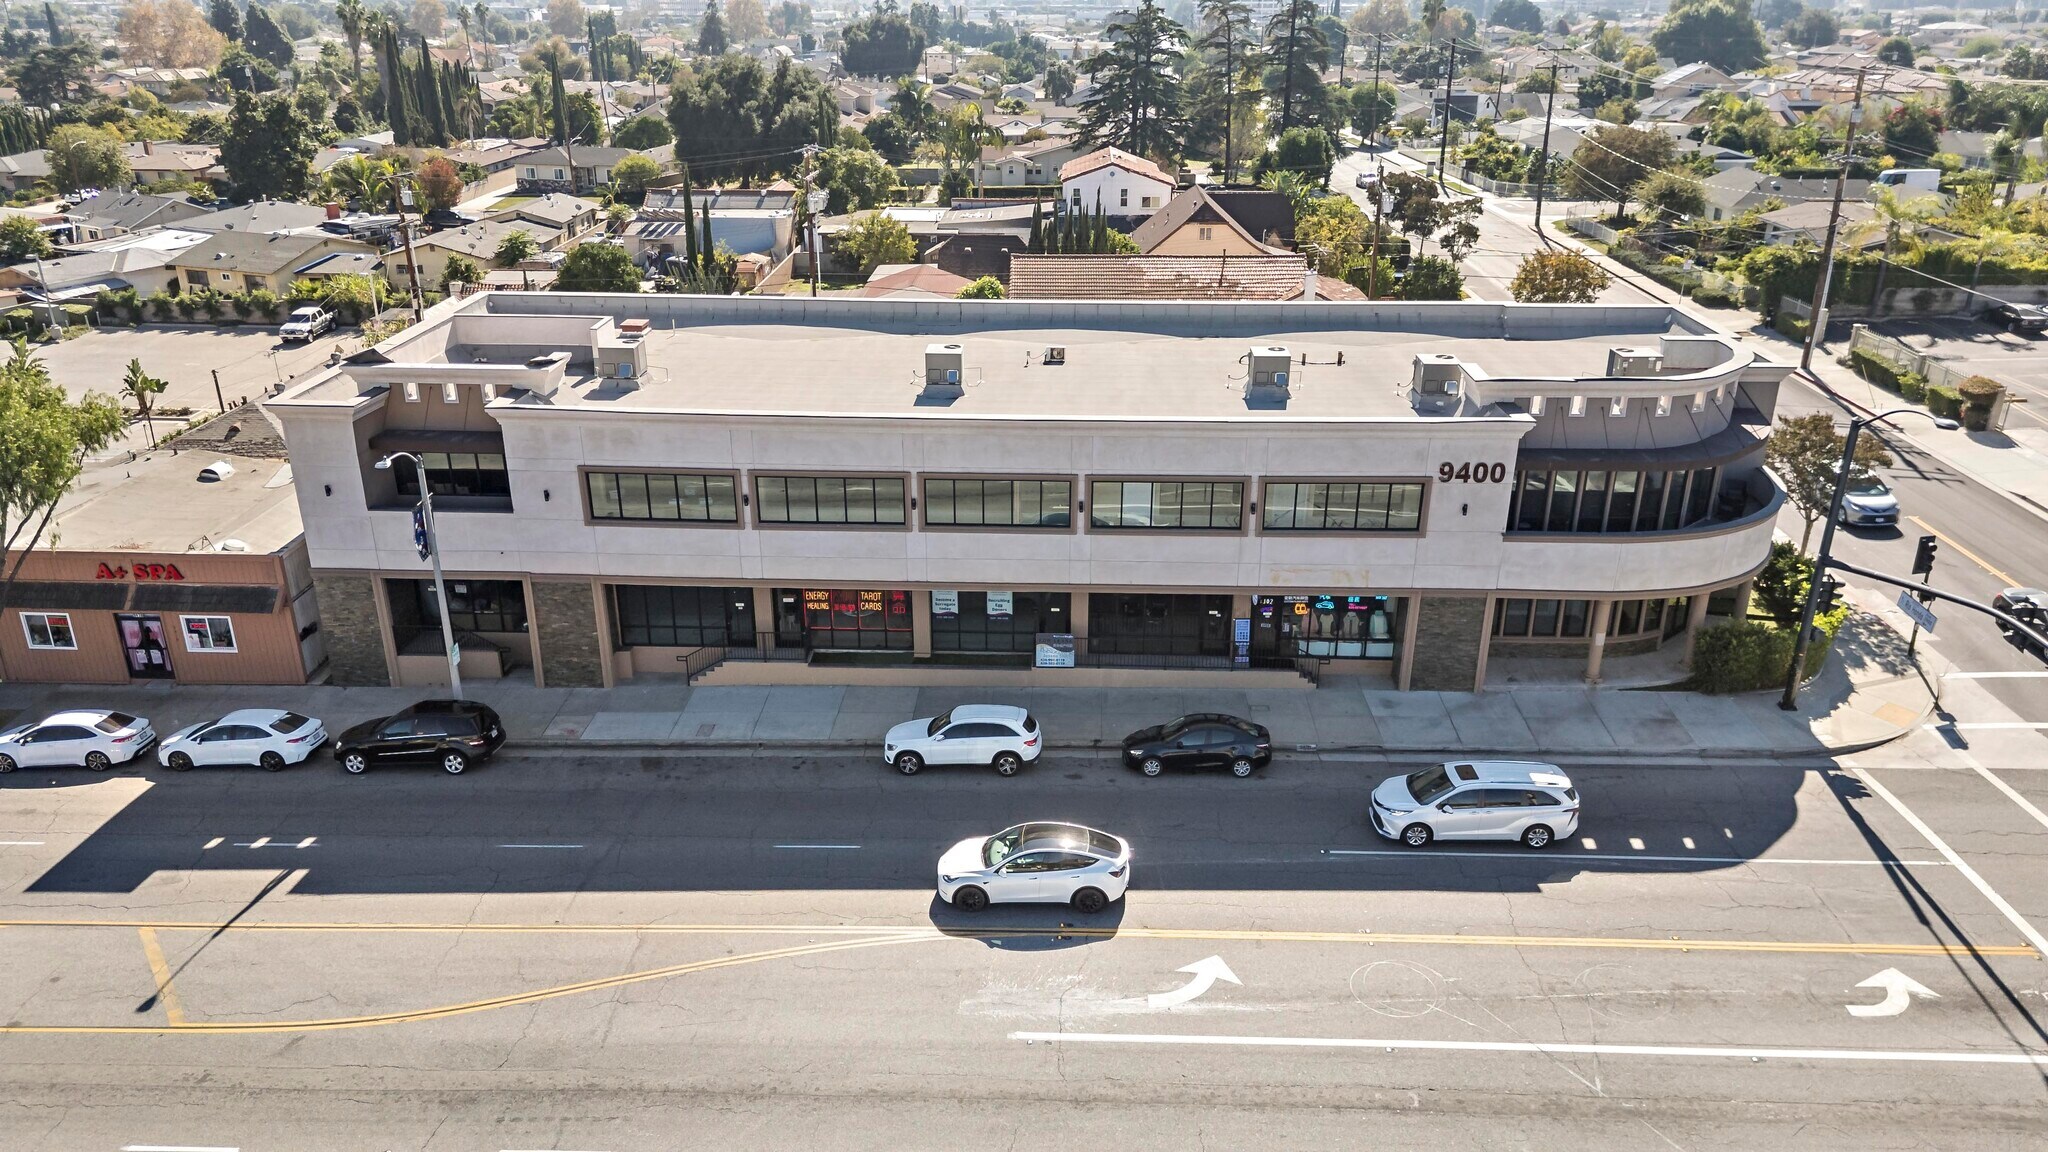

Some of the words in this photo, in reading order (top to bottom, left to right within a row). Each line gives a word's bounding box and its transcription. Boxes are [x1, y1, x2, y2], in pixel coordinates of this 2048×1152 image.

[1438, 461, 1506, 483] 9400
[95, 562, 129, 579] A+
[132, 563, 185, 580] SPA
[806, 591, 829, 600] ENERGY
[861, 592, 882, 601] TAROT
[807, 602, 829, 610] HEALING
[860, 602, 882, 611] CARDS
